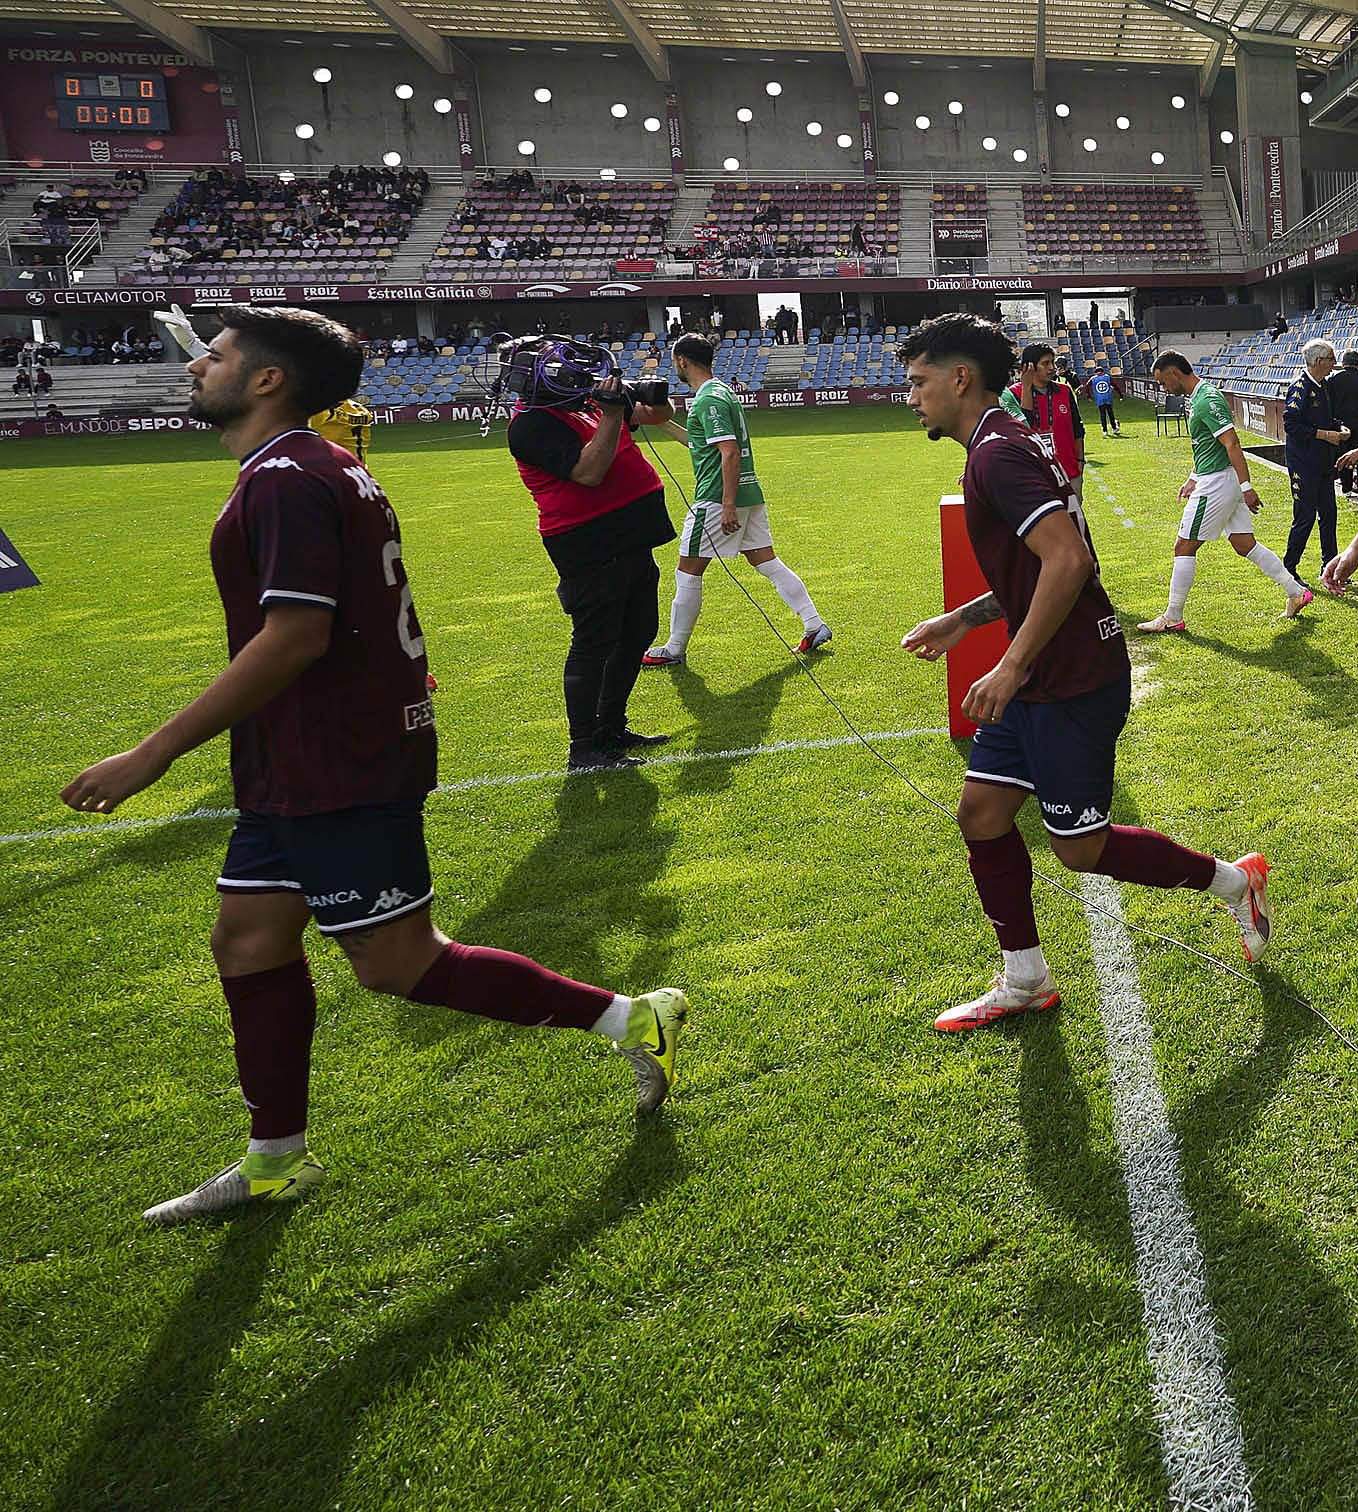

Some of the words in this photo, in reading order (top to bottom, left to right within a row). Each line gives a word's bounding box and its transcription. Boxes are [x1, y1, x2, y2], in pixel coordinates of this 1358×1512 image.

[8, 48, 77, 62] FORZA
[66, 79, 80, 96] 0
[140, 81, 153, 97] 0
[77, 106, 150, 124] 00:00
[1267, 141, 1281, 199] Pontevedra
[927, 279, 960, 290] Diario
[972, 278, 1032, 290] Pontevedra
[54, 291, 167, 304] CELTAMOTOR
[195, 288, 232, 297] FROIZ
[250, 287, 286, 297] FROIZ
[303, 287, 338, 296] FROIZ
[368, 287, 422, 299] Estrella
[424, 286, 475, 299] Galicia
[769, 391, 804, 403] FROIZ
[815, 390, 848, 401] FROIZ
[128, 418, 184, 431] SEPO
